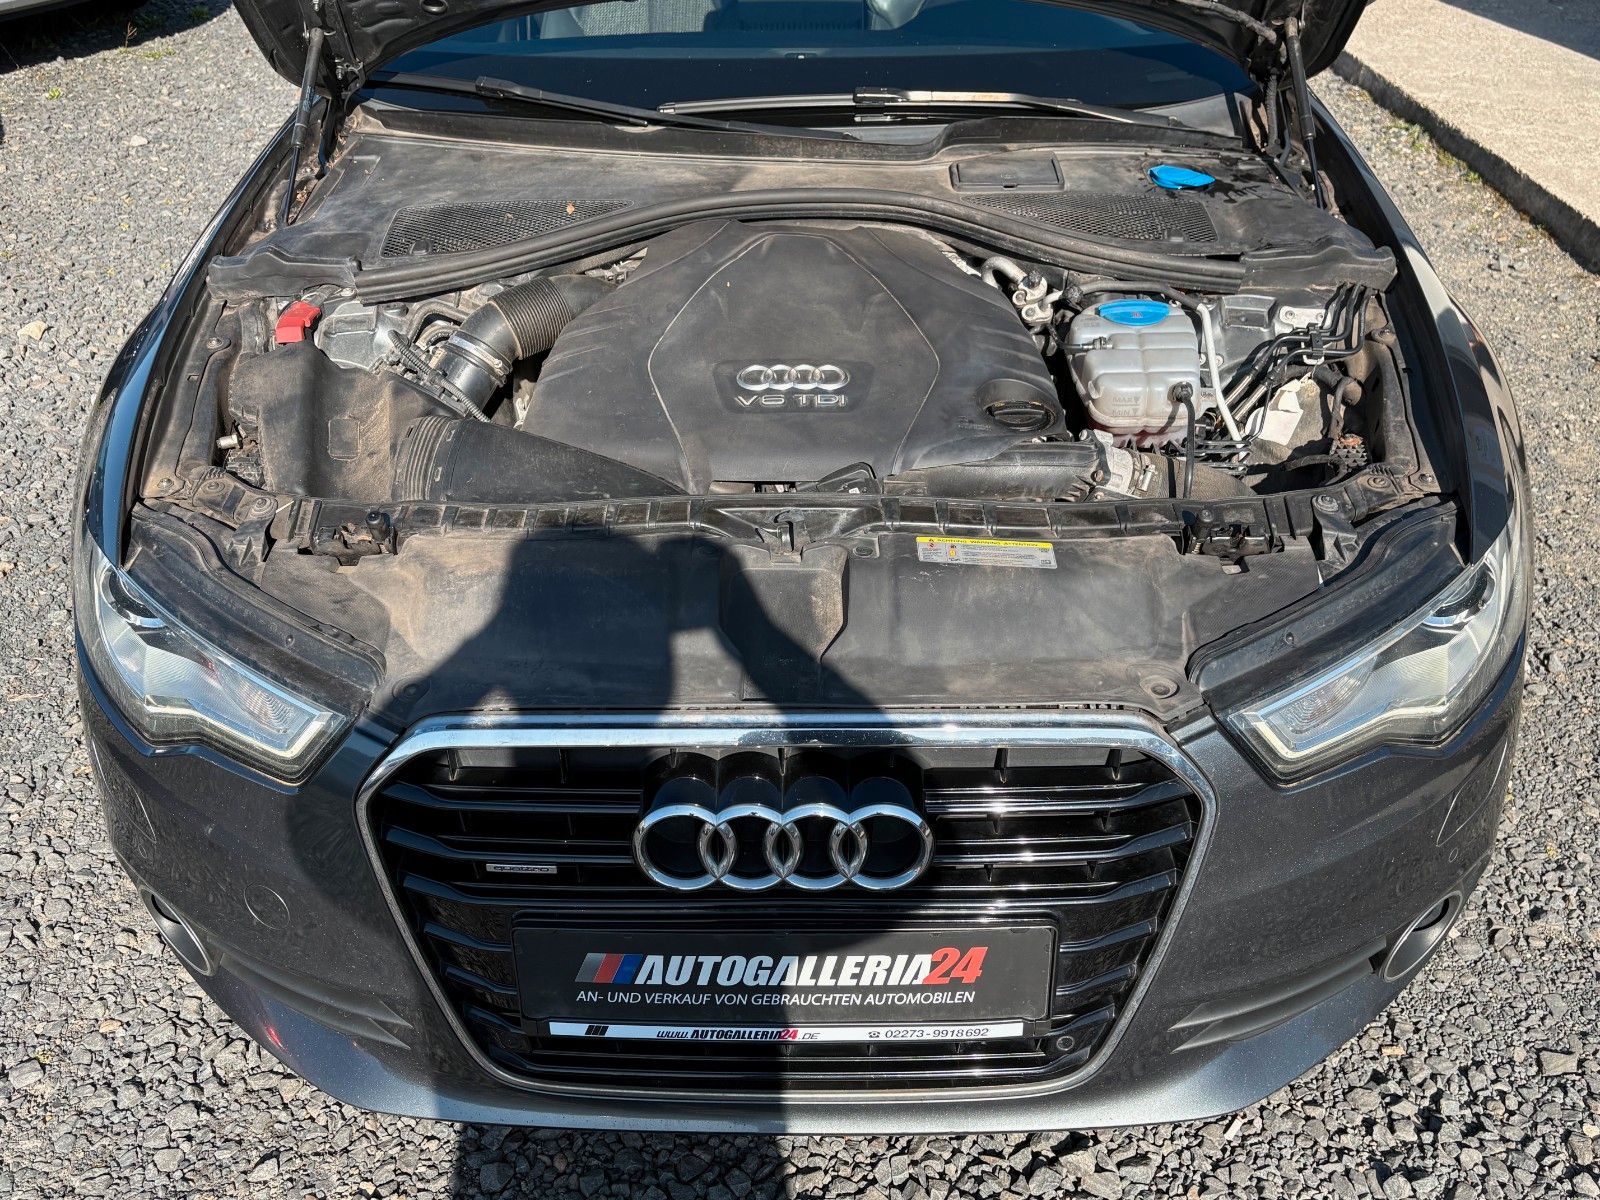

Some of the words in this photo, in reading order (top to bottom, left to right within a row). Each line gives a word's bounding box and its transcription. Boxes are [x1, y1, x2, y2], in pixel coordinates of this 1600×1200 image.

[735, 394, 785, 407] V6
[793, 394, 848, 407] TDI
[493, 865, 550, 873] quattro
[634, 946, 989, 987] AUTOGALLERIA24
[576, 990, 604, 1003] AN-
[607, 991, 641, 1004] UND
[644, 992, 712, 1006] VERKAUF
[715, 993, 748, 1006] VON
[751, 993, 862, 1006] GEBRAUCHTEN
[863, 991, 976, 1006] AUTOMOBILEN
